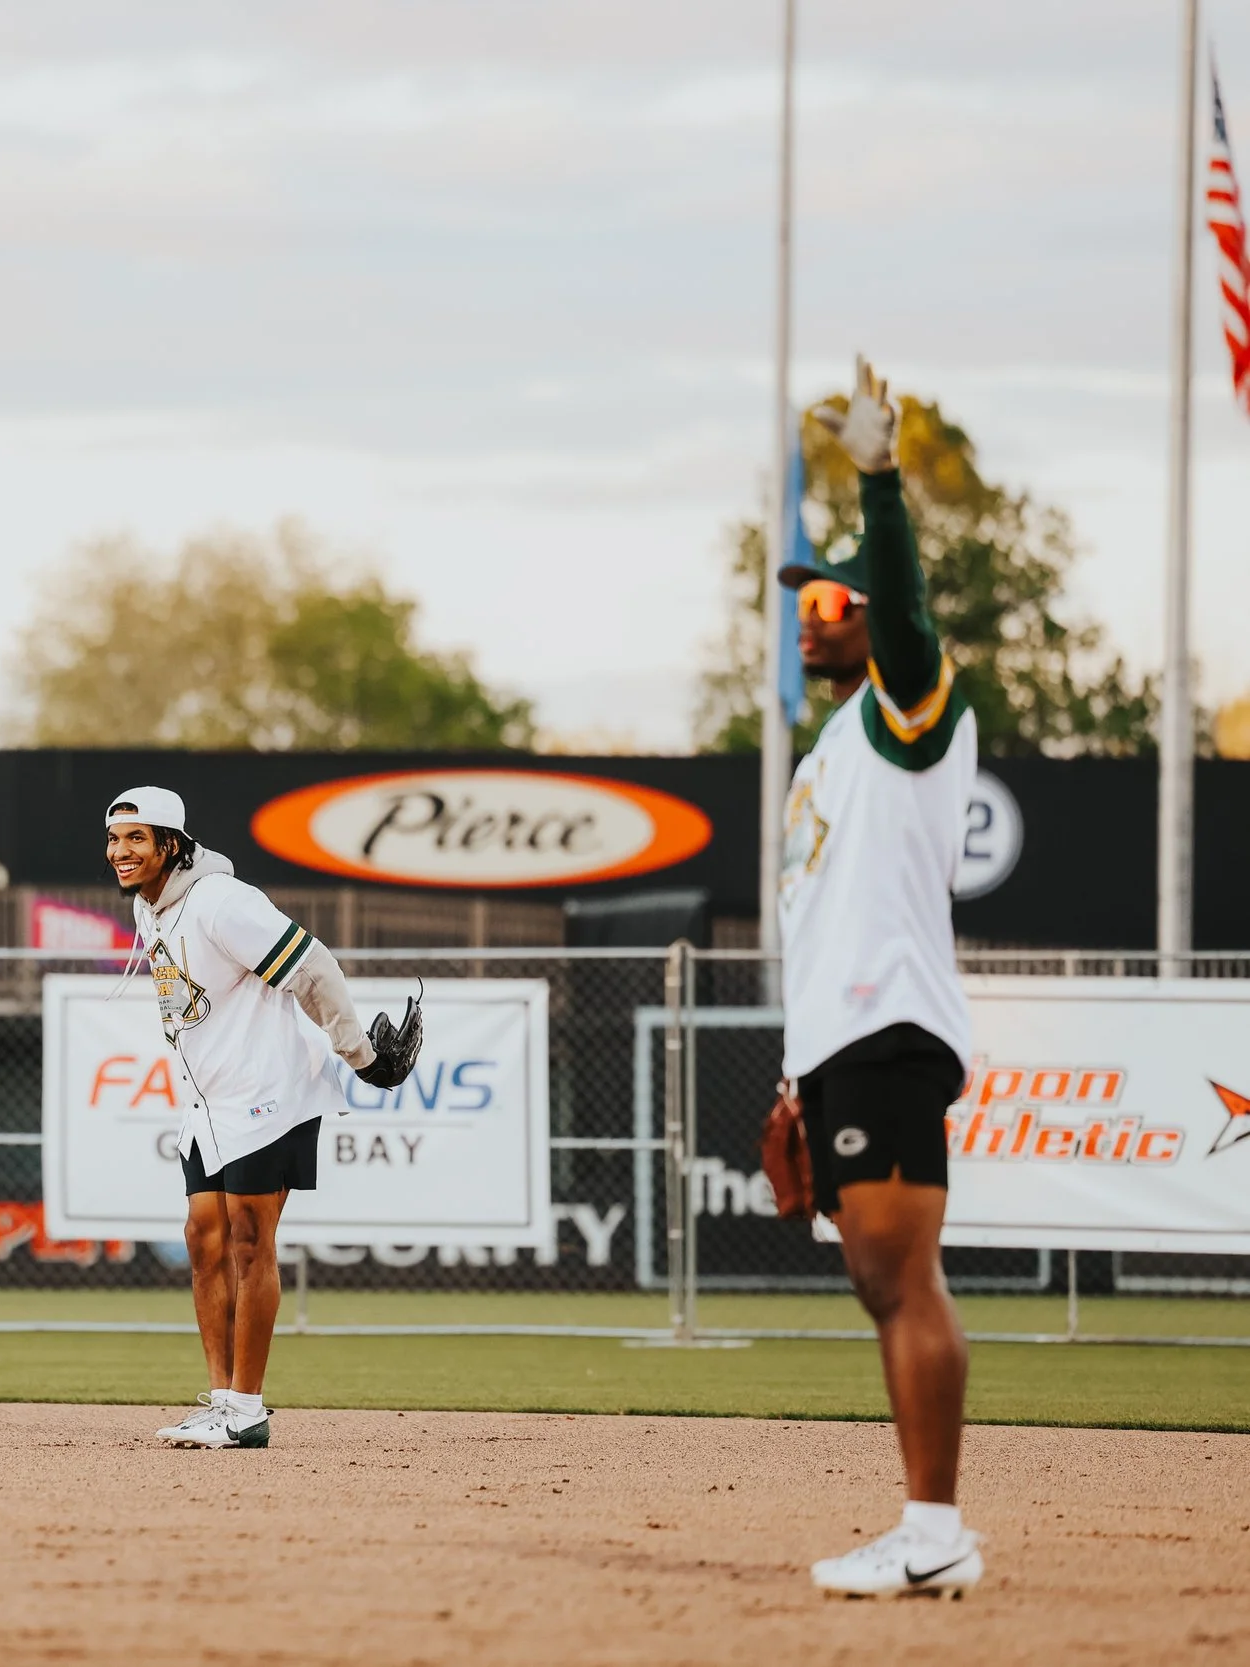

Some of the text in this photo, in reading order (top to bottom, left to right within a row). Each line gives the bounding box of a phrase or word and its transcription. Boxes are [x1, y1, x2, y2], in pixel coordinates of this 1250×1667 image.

[363, 791, 601, 862] Pierce
[334, 1133, 423, 1165] BAY
[945, 1110, 1181, 1162] hletic
